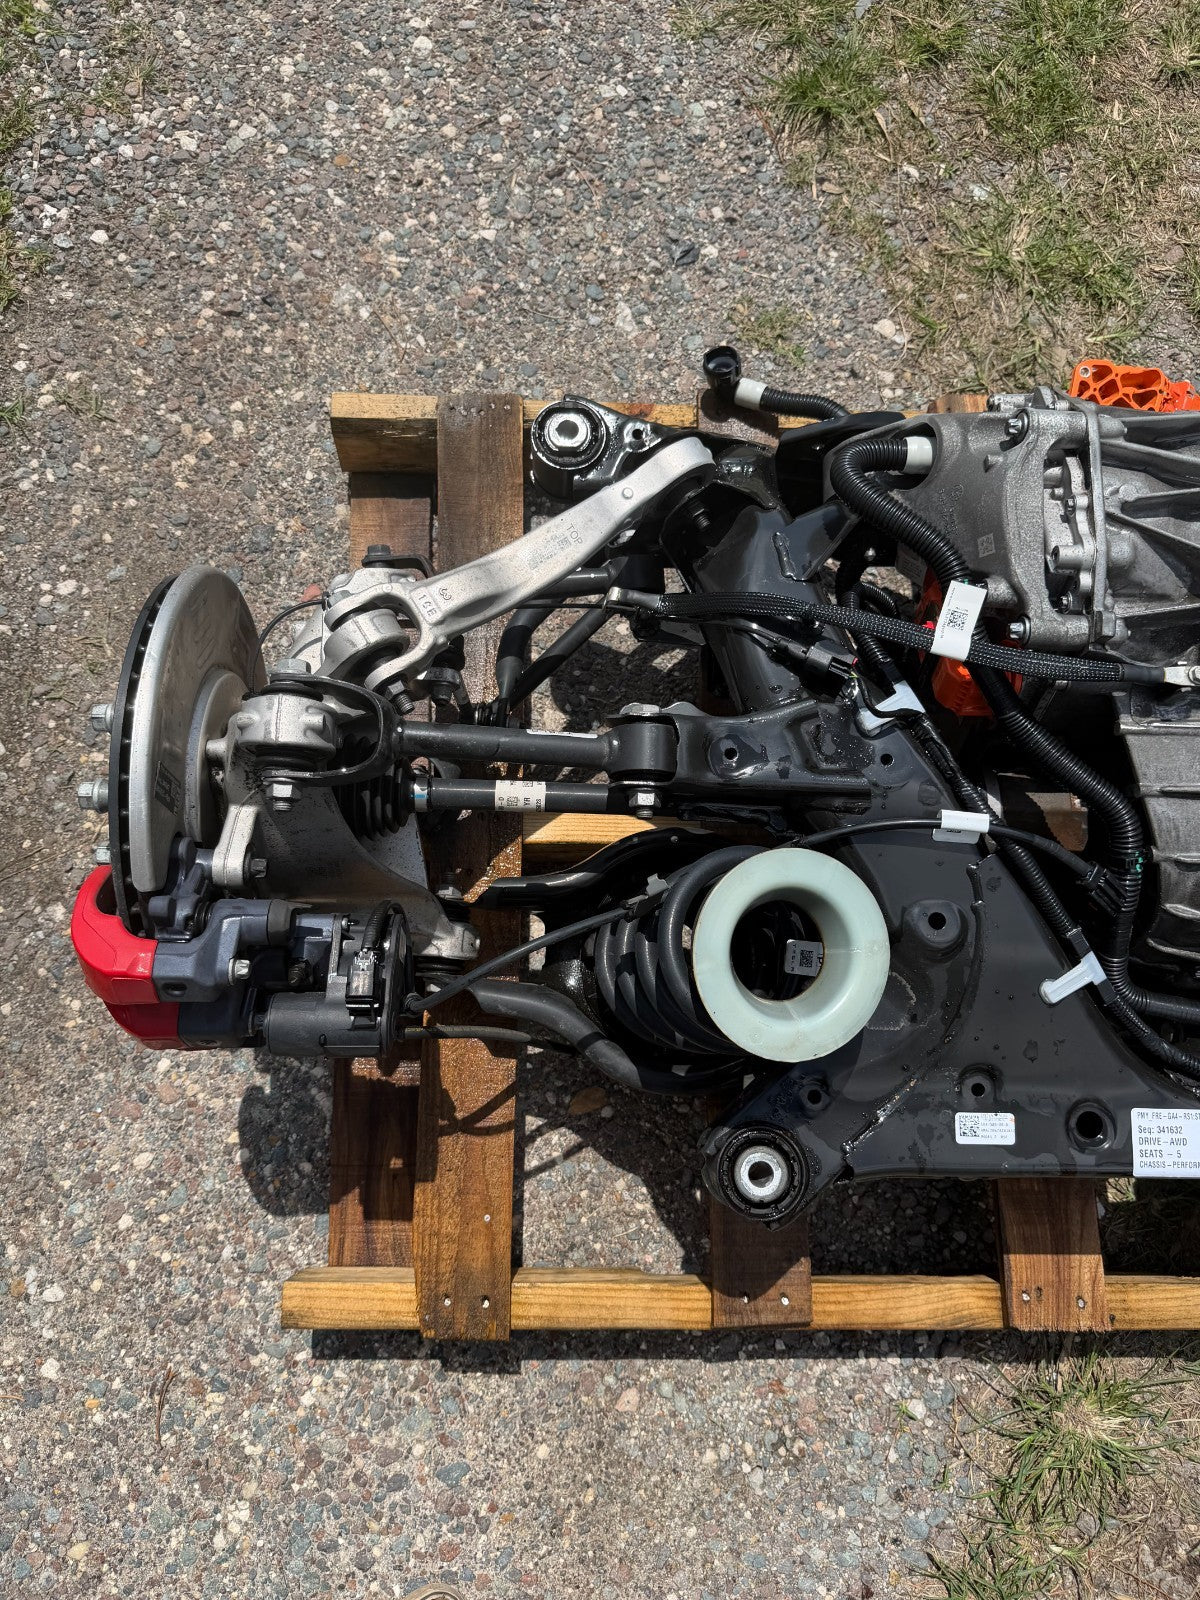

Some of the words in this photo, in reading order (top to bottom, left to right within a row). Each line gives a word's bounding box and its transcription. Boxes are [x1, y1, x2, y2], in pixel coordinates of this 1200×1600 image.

[567, 522, 583, 544] TOP
[1137, 1124, 1154, 1136] Seq:
[1156, 1125, 1183, 1135] 341632
[1139, 1149, 1163, 1158] SEATS
[1176, 1149, 1182, 1159] 5
